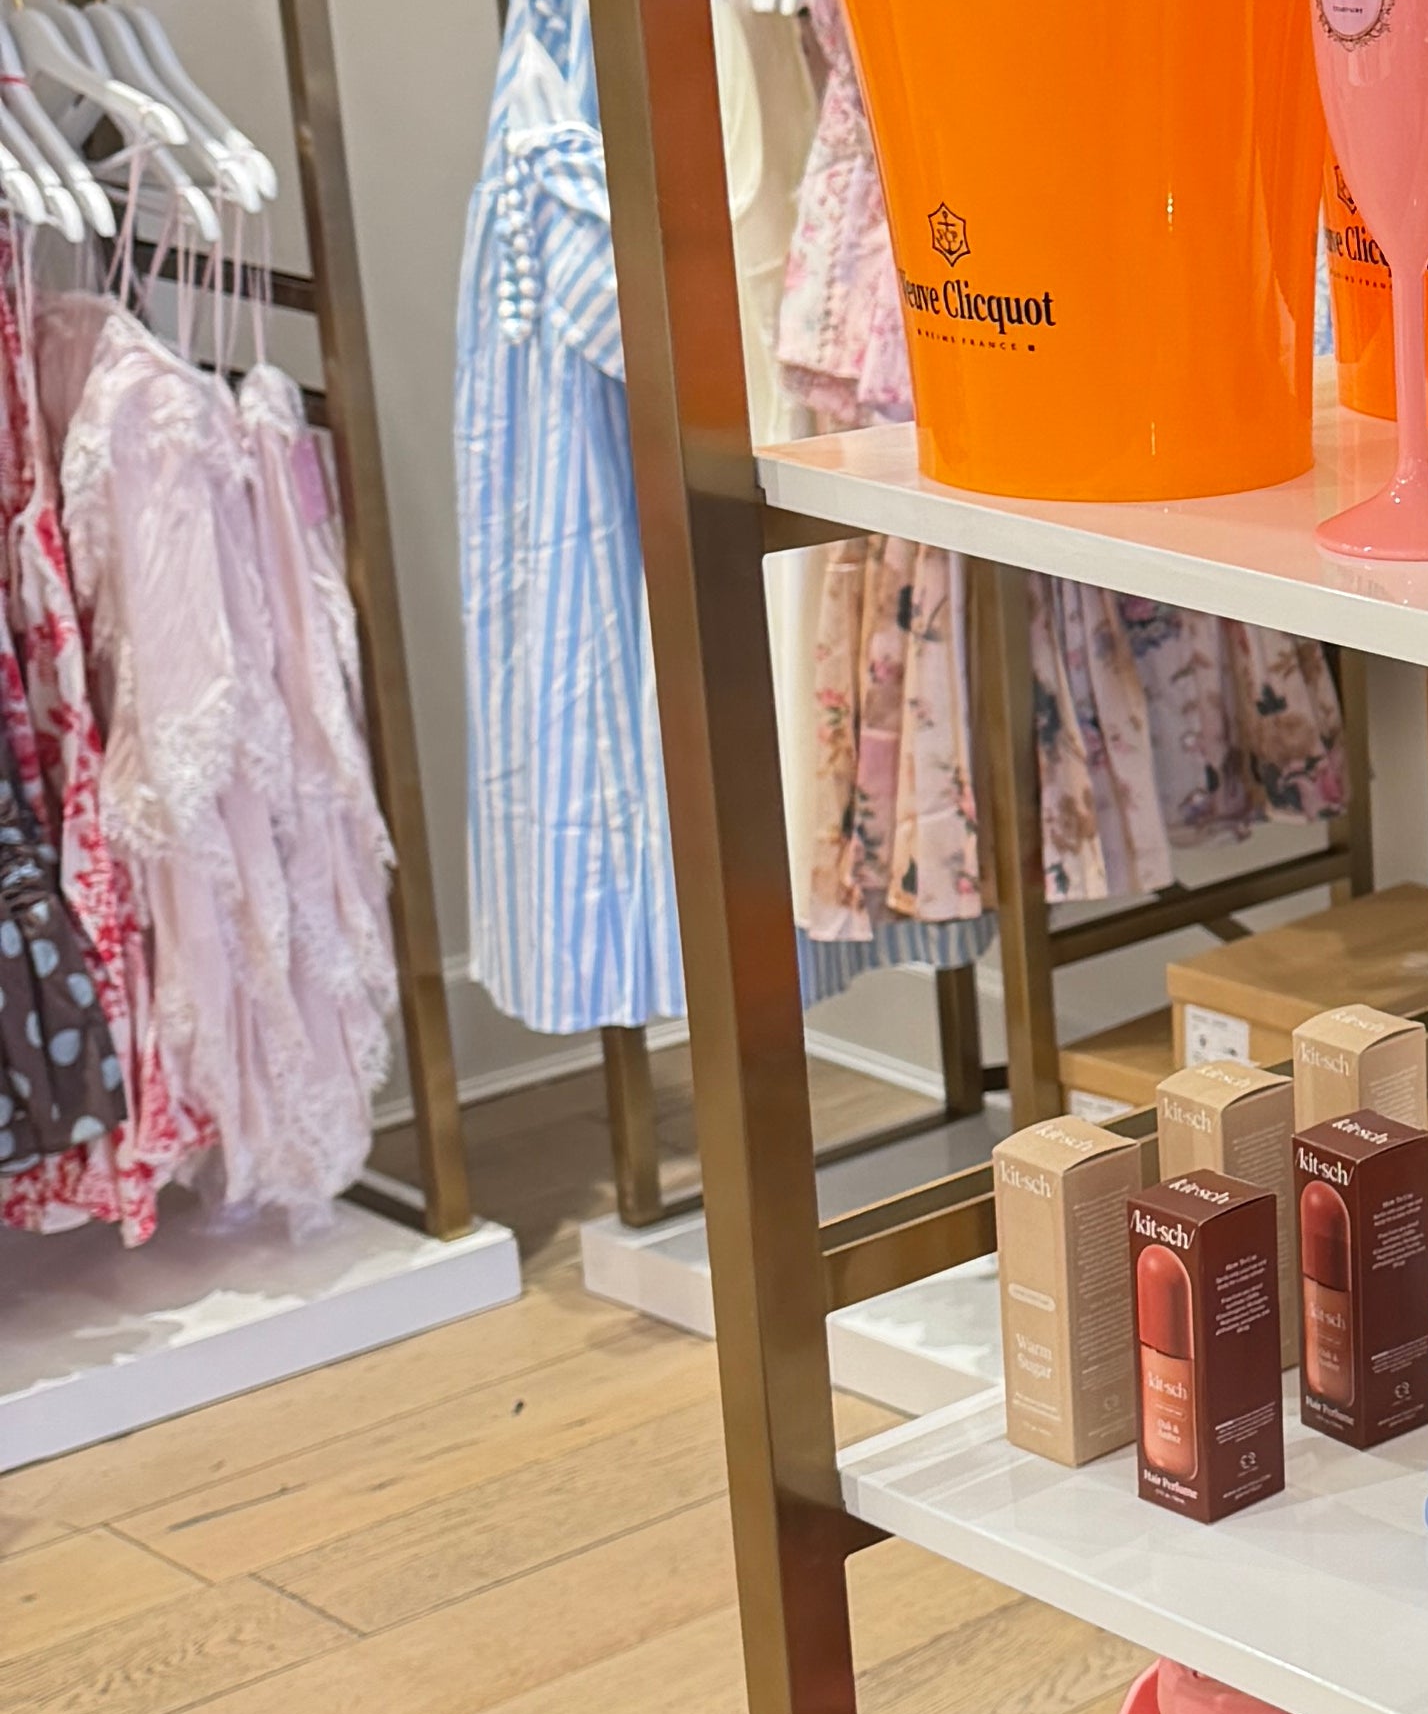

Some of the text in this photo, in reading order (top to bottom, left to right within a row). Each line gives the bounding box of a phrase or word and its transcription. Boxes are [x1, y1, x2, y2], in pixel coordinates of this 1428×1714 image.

[942, 278, 1057, 335] Clicquot
[1014, 1332, 1053, 1361] Warm
[1016, 1351, 1053, 1381] Sugar
[1143, 1468, 1198, 1501] Hair Perfume
